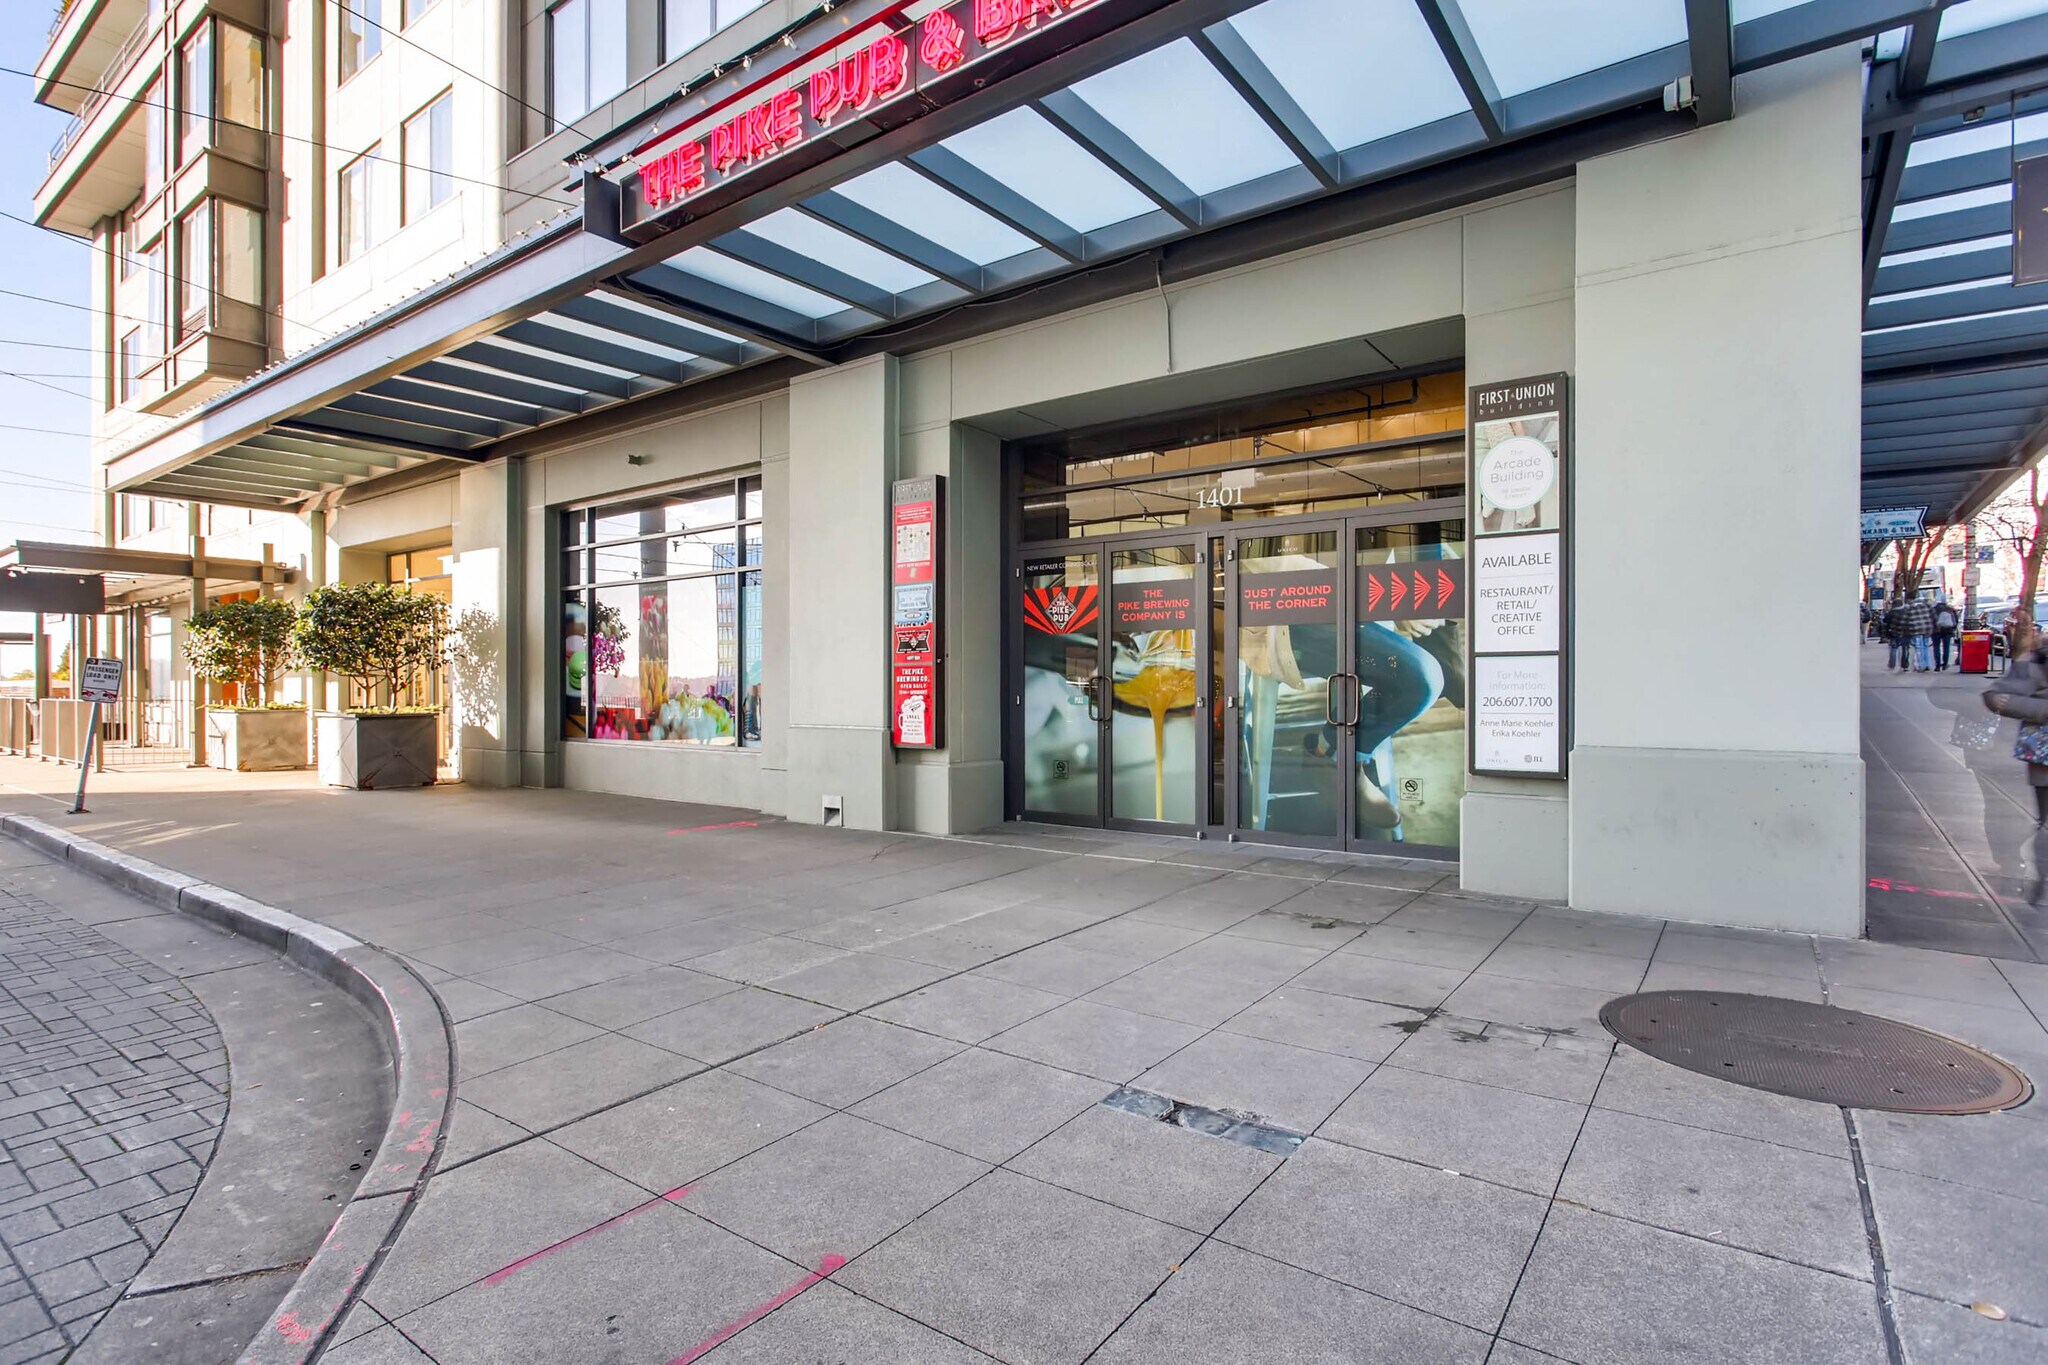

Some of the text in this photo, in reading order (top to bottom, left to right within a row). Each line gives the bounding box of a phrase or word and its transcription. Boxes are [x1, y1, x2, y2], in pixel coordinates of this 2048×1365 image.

[639, 140, 705, 209] THE
[710, 89, 802, 176] PIKE
[809, 35, 907, 127] PUB
[921, 8, 964, 72] &
[1479, 389, 1511, 406] FIRST
[1516, 382, 1555, 400] UNION
[1493, 456, 1541, 470] Arcade
[1490, 470, 1544, 483] Building
[1195, 485, 1244, 509] 1401
[1482, 552, 1552, 568] AVAILABLE
[1143, 589, 1163, 598] THE
[1244, 585, 1331, 599] JUST AROUND
[1480, 585, 1554, 598] RESTAURANT/
[1052, 606, 1069, 614] PIKE
[1118, 598, 1190, 611] PIKE BREWING
[1248, 597, 1327, 611] THE CORNER
[1496, 599, 1537, 611] RETAIL/
[1121, 610, 1186, 622] COMPANY IS
[1491, 611, 1542, 624] CREATIVE
[1497, 625, 1535, 636] OFFICE
[88, 666, 119, 674] PASSENGER
[1497, 670, 1538, 680] For More
[1482, 696, 1553, 708] 206.607.1700
[1511, 730, 1541, 738] Koehler
